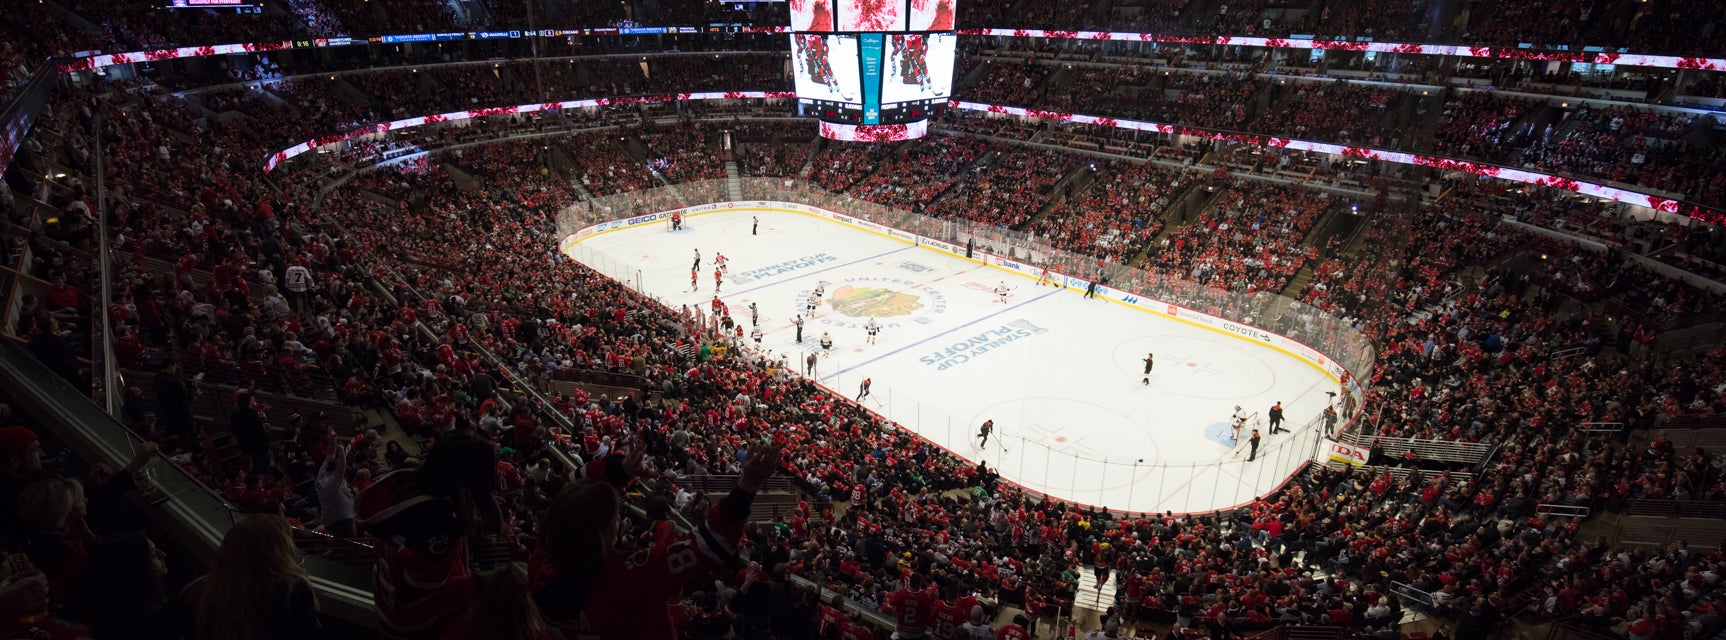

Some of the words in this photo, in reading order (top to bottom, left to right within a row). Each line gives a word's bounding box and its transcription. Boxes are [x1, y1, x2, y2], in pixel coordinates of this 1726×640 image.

[628, 214, 657, 226] GEICO
[927, 240, 949, 251] LEXUS
[740, 260, 797, 277] STANLEY
[800, 253, 826, 262] CUP
[753, 256, 837, 280] PLAYOFFS
[295, 273, 302, 283] 7
[844, 277, 915, 286] UNITED
[923, 286, 947, 314] CENTER
[1223, 323, 1260, 338] COYOTE
[919, 326, 1013, 366] PLAYOFFS
[970, 329, 1032, 358] STANLEY
[937, 354, 970, 371] CUP
[666, 538, 698, 575] 81
[903, 607, 917, 624] 2
[935, 618, 955, 639] 19
